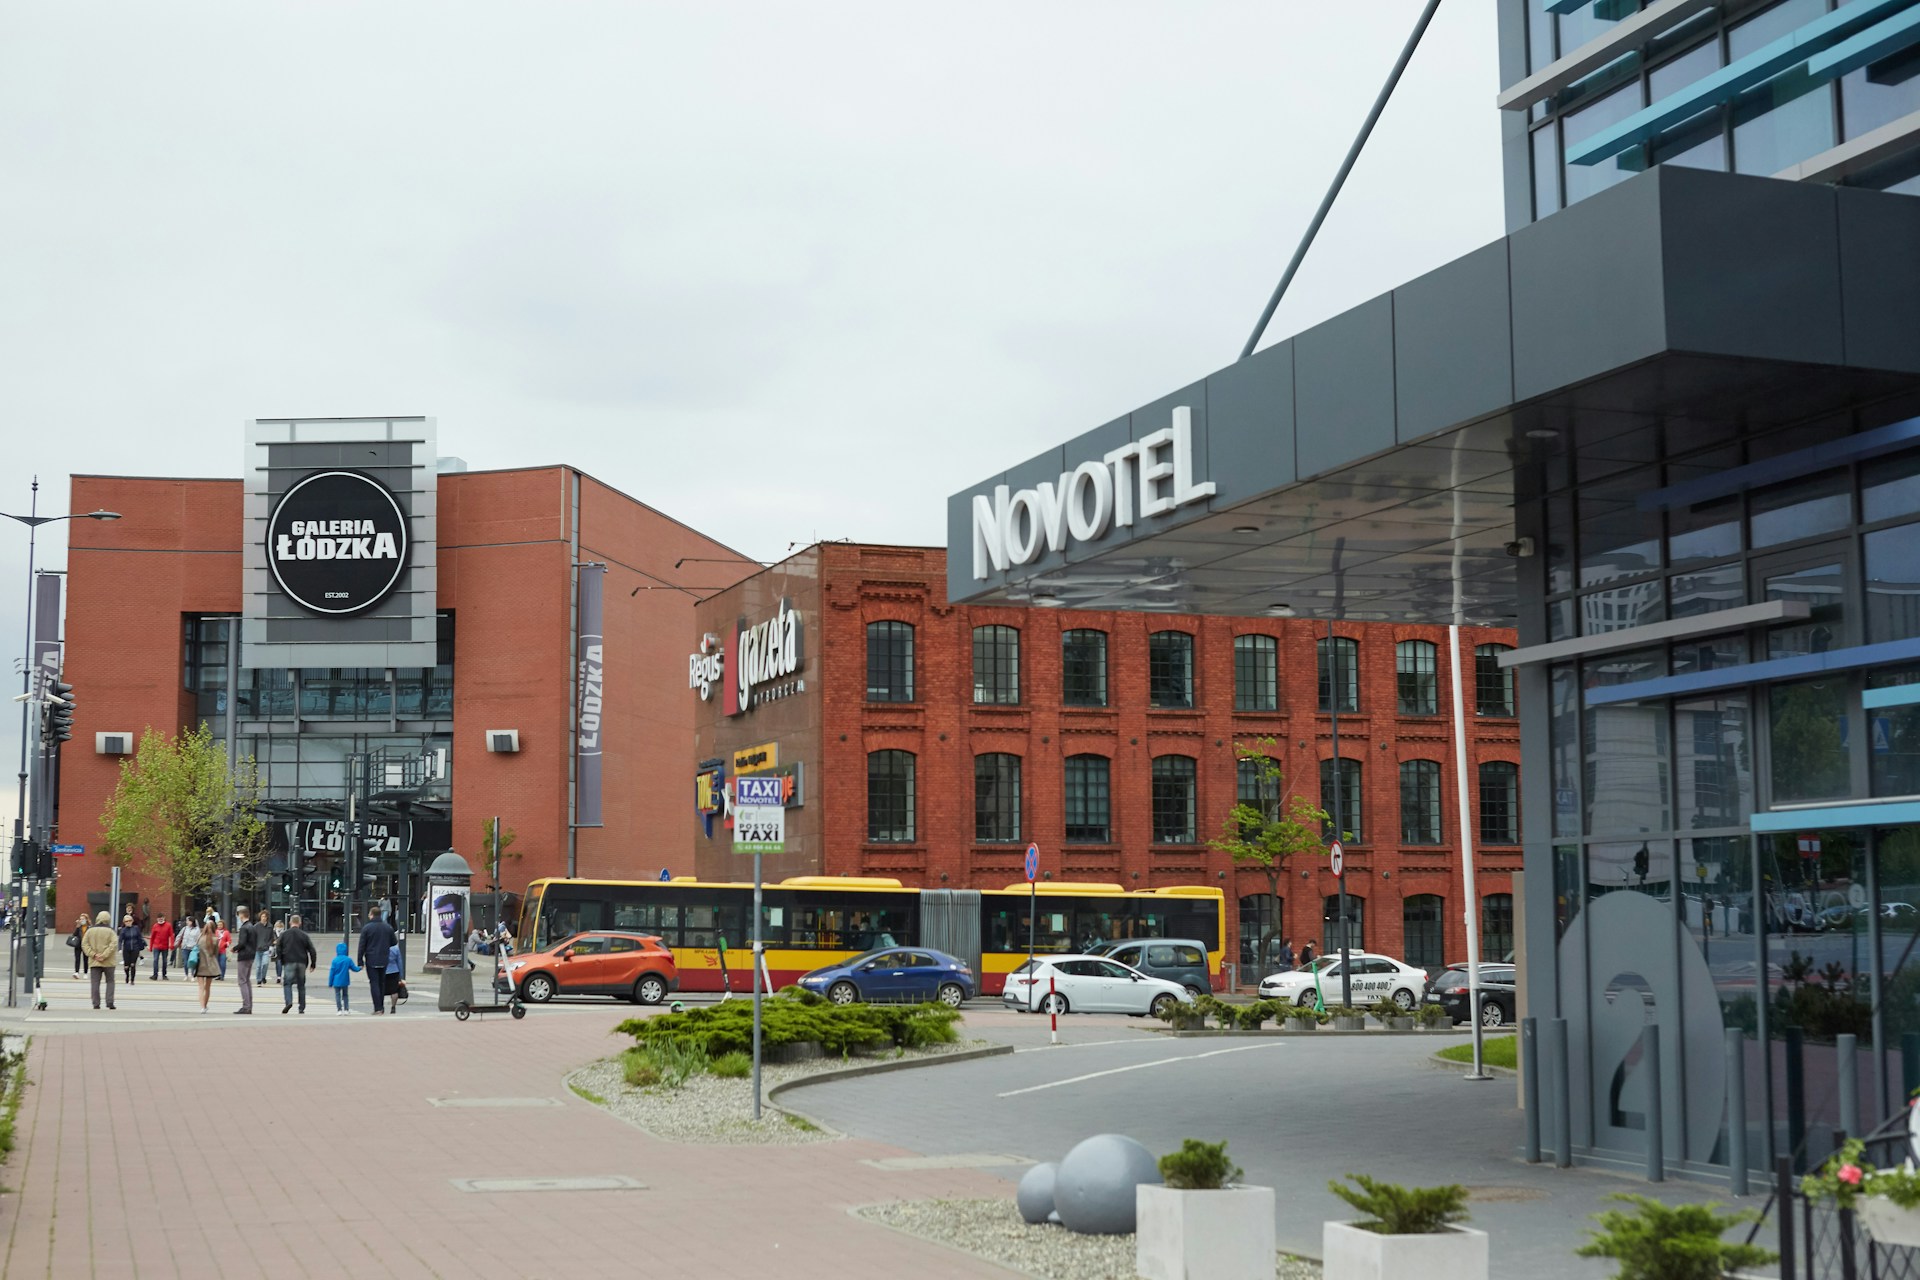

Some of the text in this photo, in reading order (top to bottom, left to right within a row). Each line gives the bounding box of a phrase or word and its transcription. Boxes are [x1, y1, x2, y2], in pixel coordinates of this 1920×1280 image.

[973, 406, 1216, 580] NOVOTEL
[291, 520, 376, 536] GALERIA
[276, 532, 398, 560] ŁÓDZKA
[738, 597, 797, 712] gazeta
[689, 651, 721, 702] Regus
[740, 780, 779, 798] TAXI
[739, 797, 779, 805] NOVOTEL
[739, 822, 780, 831] POSTÓJ
[739, 830, 779, 841] TAXI
[1604, 970, 1657, 1130] 2
